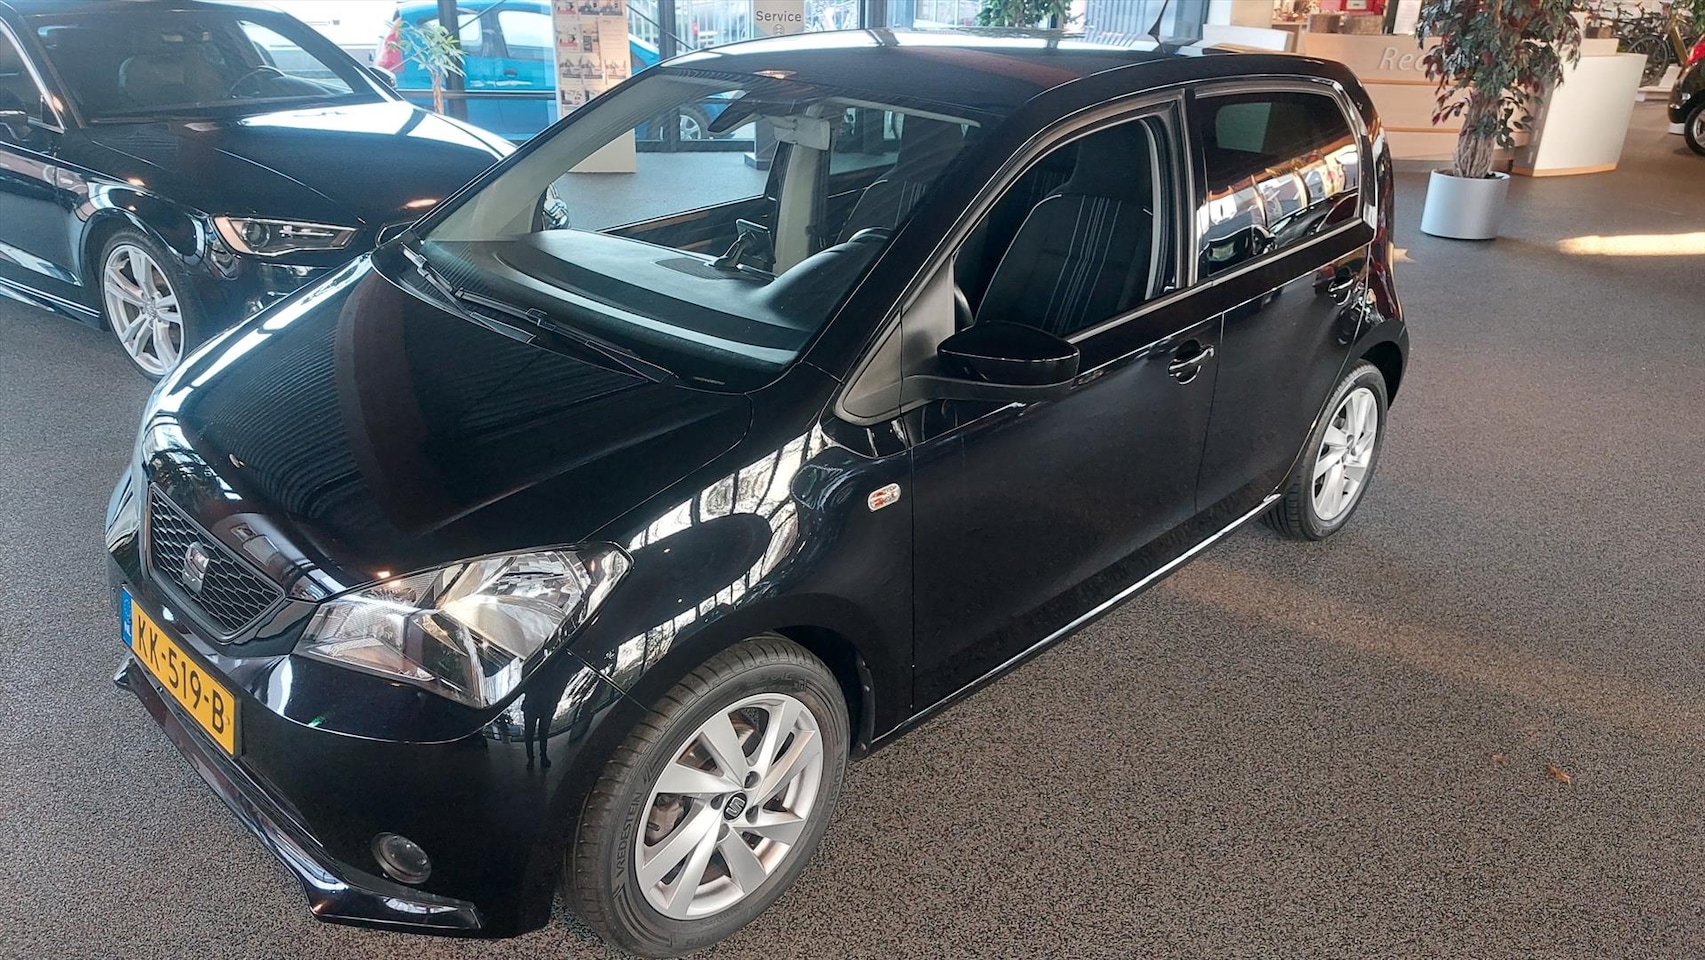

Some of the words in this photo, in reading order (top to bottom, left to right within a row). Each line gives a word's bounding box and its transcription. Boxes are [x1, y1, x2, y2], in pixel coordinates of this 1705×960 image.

[756, 10, 802, 22] Service
[1379, 46, 1425, 72] Rec
[138, 614, 225, 735] KK-519-B
[616, 791, 642, 878] VREDESTEIN
